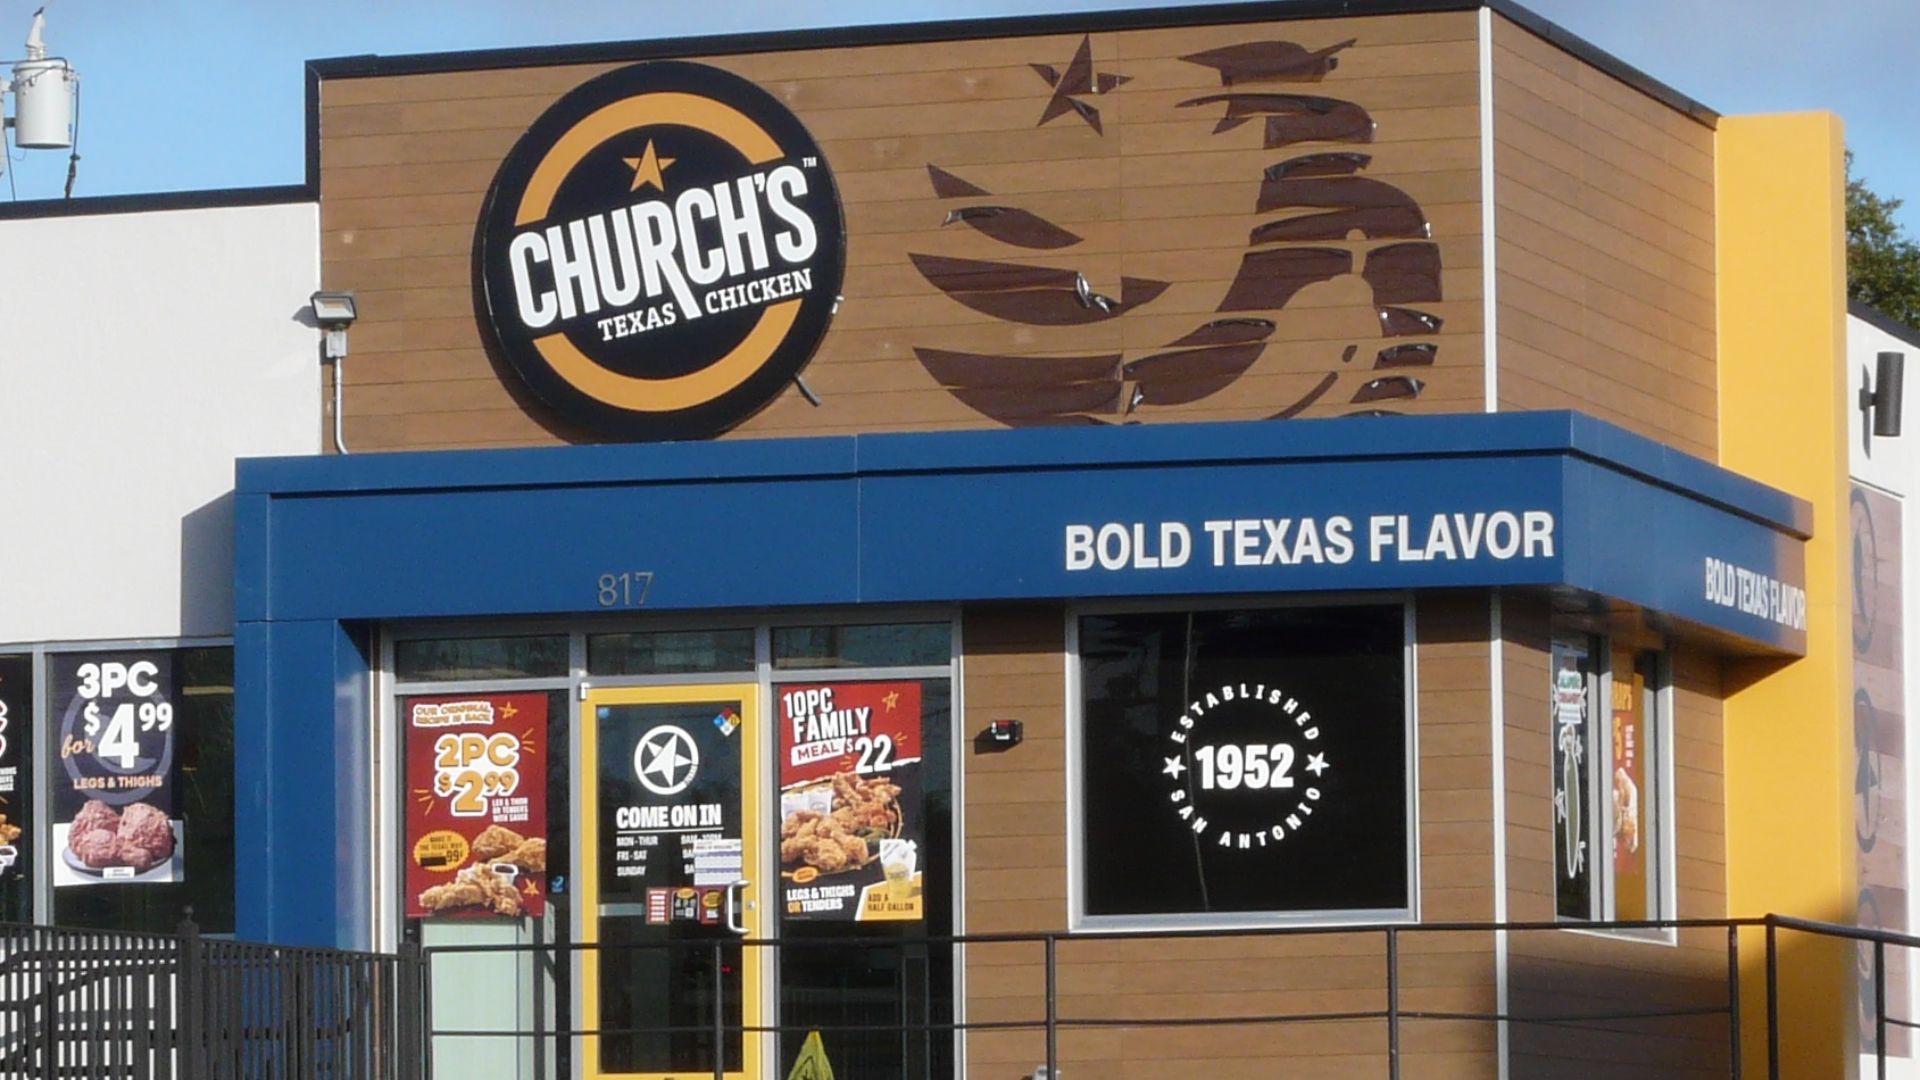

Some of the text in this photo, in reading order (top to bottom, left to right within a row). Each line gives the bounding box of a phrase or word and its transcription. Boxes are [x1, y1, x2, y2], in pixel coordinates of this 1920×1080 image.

[509, 165, 818, 328] CHURCH'S
[597, 268, 813, 341] TEXAS CHICKEN
[1065, 511, 1555, 570] BOLD TEXAS FLAVOR
[598, 572, 654, 606] 817
[1705, 556, 1806, 632] BOLD TEXAS FLAVOR
[76, 661, 159, 698] 3PC
[783, 688, 833, 718] 10PC
[1171, 683, 1320, 744] ESTABLISHED
[793, 706, 869, 743] FAMILY
[60, 734, 95, 759] for
[437, 735, 517, 768] 2PC
[797, 742, 839, 760] MEAL
[74, 775, 163, 790] LEGS & THIGHS
[1195, 743, 1295, 790] 1952
[616, 804, 722, 829] COME ON IN
[1171, 788, 1321, 849] SAN ANTONIO
[787, 887, 810, 901] LEGS
[819, 884, 855, 898] THIGHS
[801, 897, 843, 912] TENDERS
